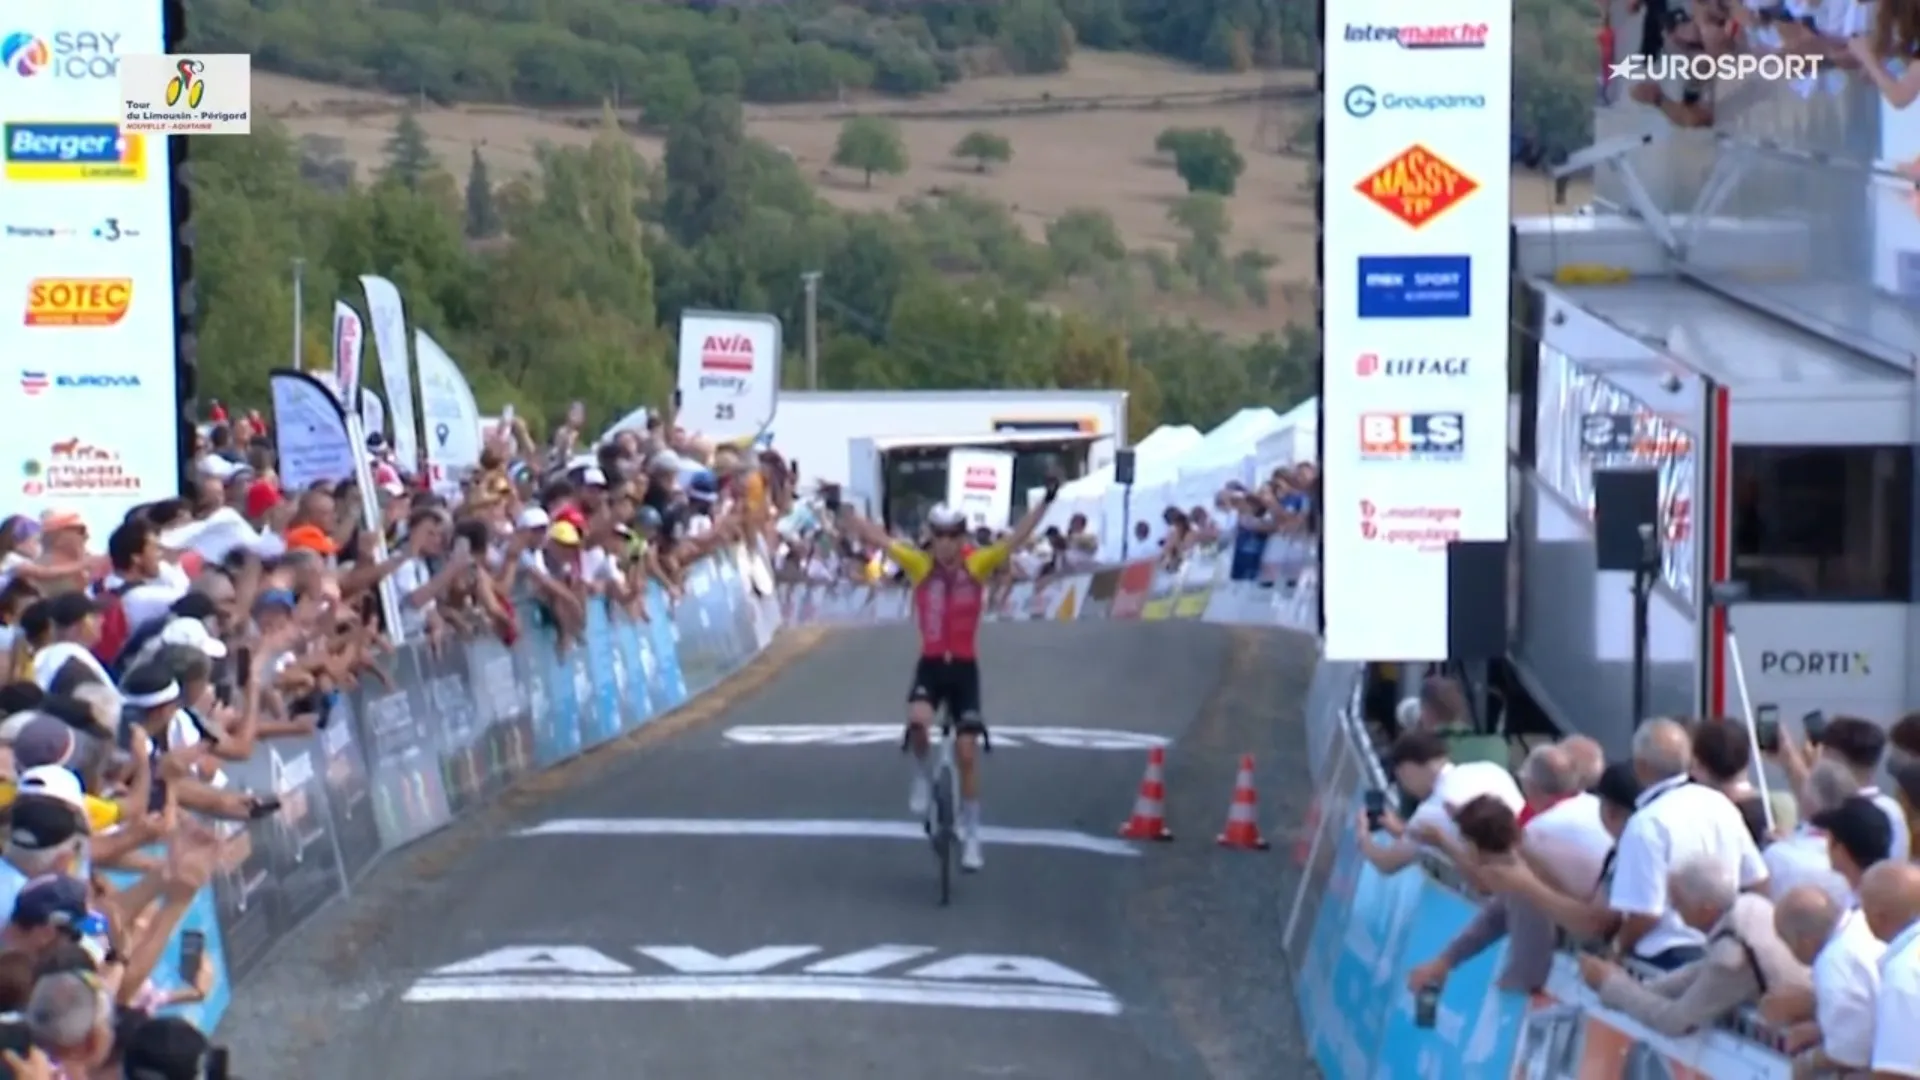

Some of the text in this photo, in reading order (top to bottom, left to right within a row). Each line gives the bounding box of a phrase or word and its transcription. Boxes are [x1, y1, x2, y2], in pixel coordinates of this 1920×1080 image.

[54, 31, 121, 54] SAY
[1344, 22, 1489, 44] Intermarché
[1382, 92, 1486, 111] Groupama
[12, 130, 111, 159] Berger
[1372, 151, 1458, 197] MASSY
[105, 218, 120, 241] 3
[31, 284, 126, 307] SOTEC
[703, 335, 753, 353] AVIA
[1385, 358, 1469, 376] EIFFAGE
[56, 375, 141, 386] EUROVIA
[714, 403, 735, 419] 25
[1363, 415, 1461, 444] BLS
[1761, 651, 1872, 675] PORTIX
[430, 944, 1101, 988] AVIA
